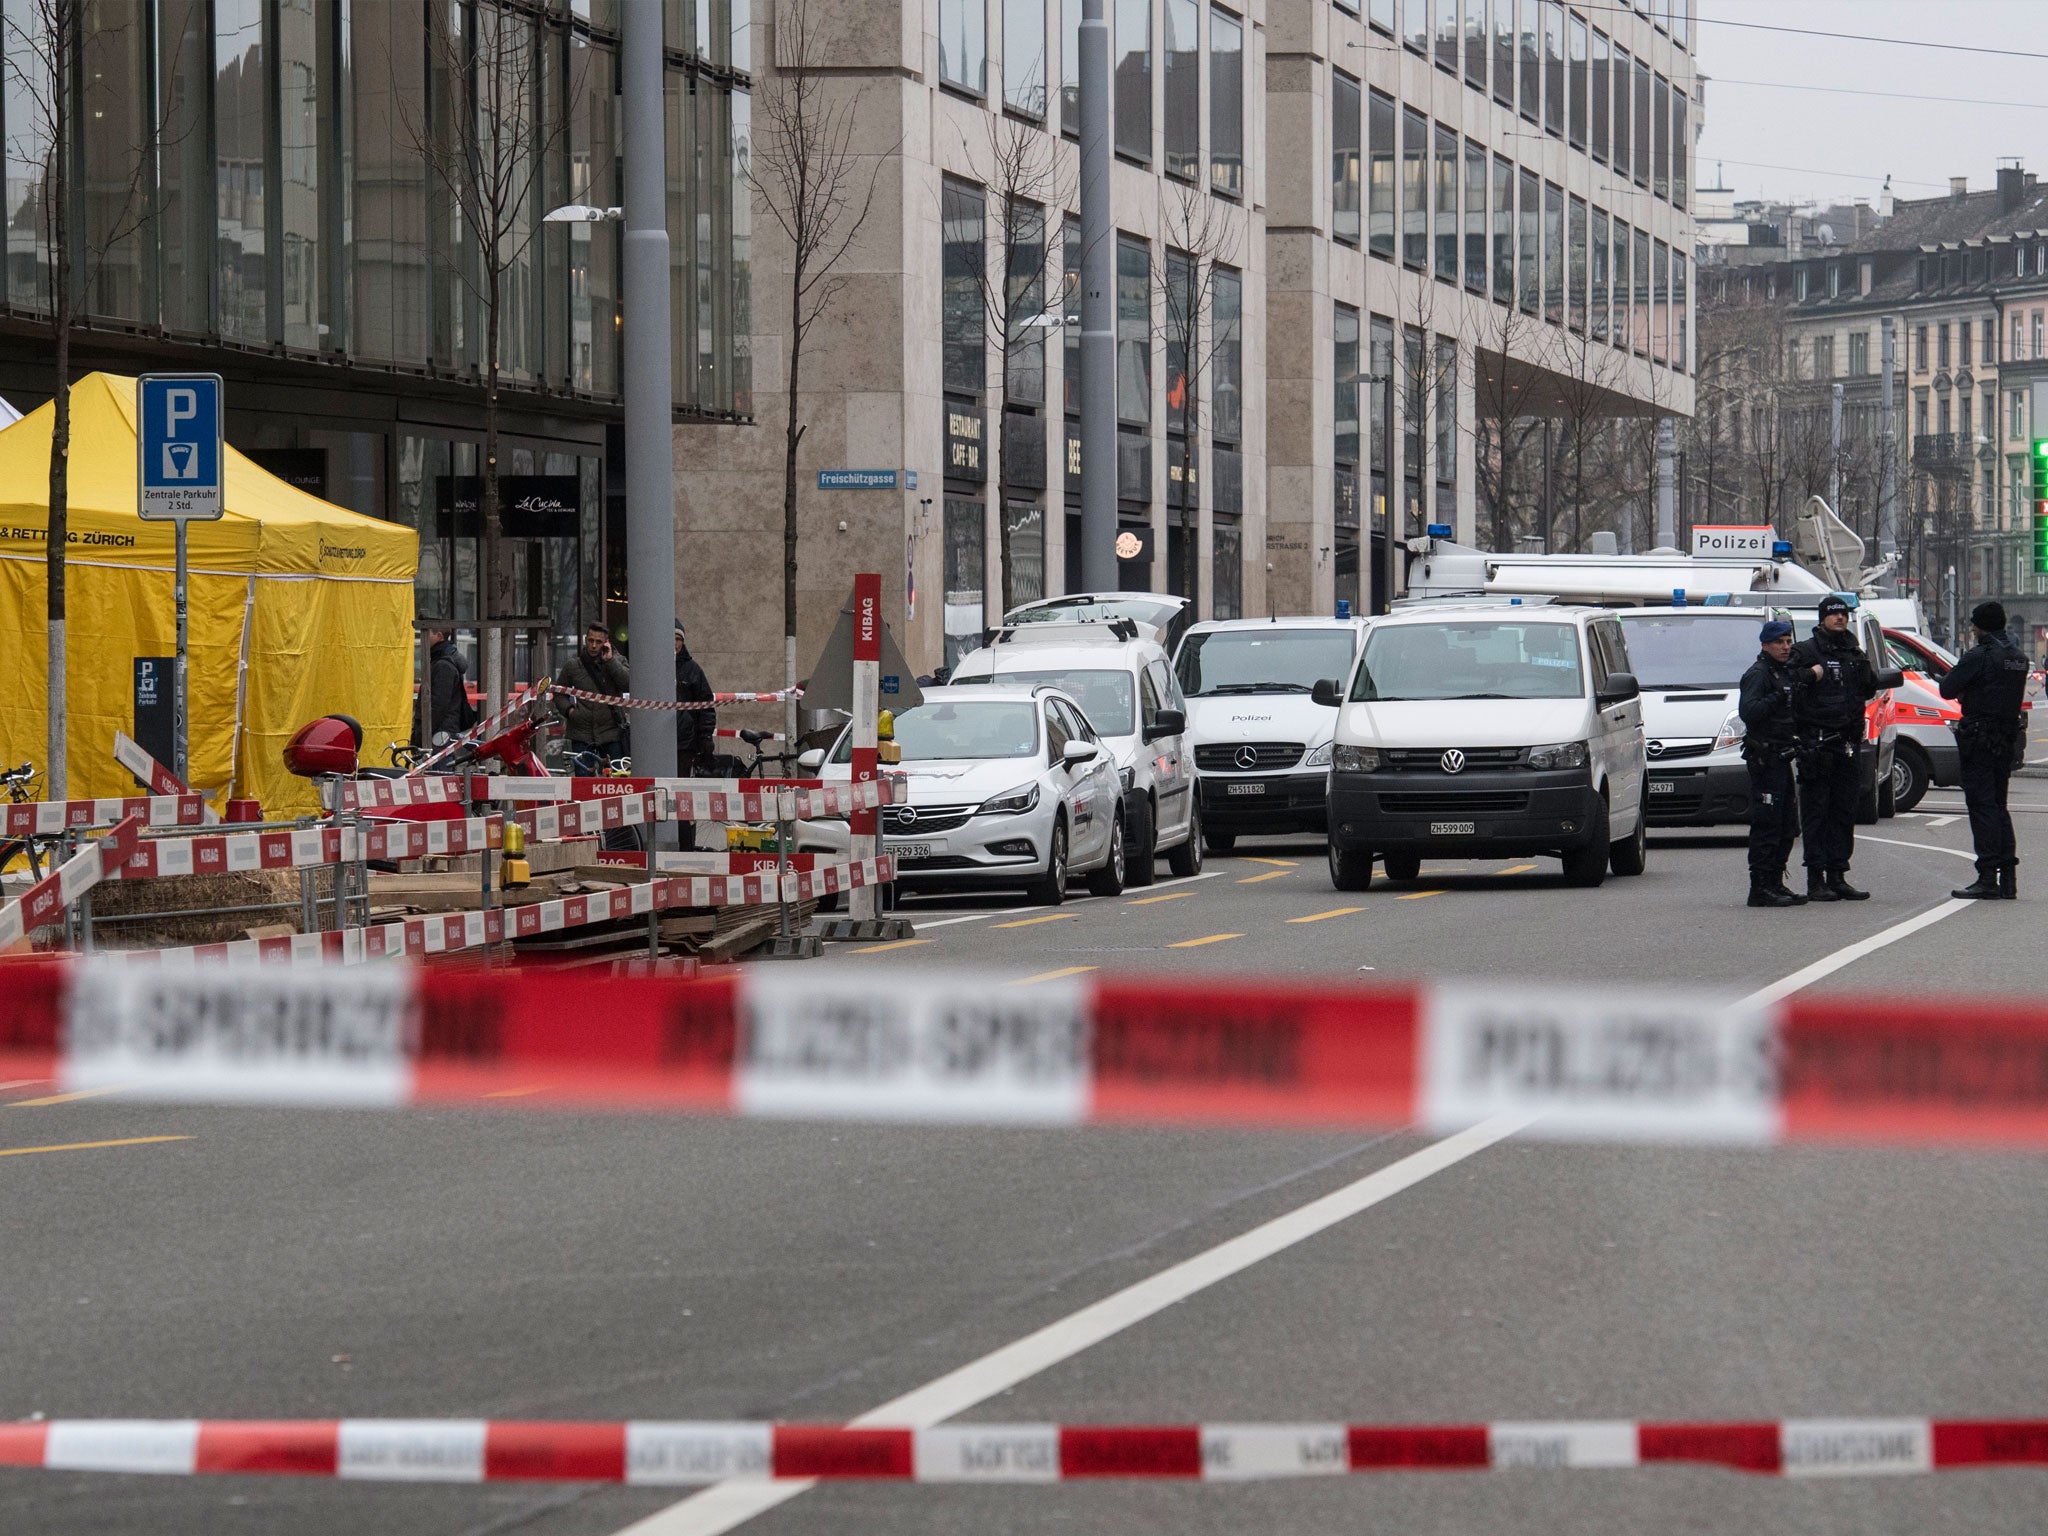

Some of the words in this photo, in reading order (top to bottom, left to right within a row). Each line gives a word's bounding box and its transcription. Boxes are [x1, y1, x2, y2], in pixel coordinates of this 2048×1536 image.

[166, 389, 197, 438] P
[821, 473, 894, 486] Freischützgasse
[144, 490, 181, 499] Zentrale
[183, 489, 217, 499] Parkuhr
[168, 501, 174, 510] 2
[176, 501, 193, 510] Std.
[12, 528, 78, 543] RETTG
[83, 531, 135, 547] ZÜRICH
[1699, 534, 1766, 549] Polizei
[861, 598, 873, 641] KIBAG
[142, 662, 153, 678] P
[1538, 658, 1570, 668] POLIZEI
[1231, 714, 1272, 722] Polizei
[592, 784, 634, 794] KIBAG
[32, 889, 53, 915] KIBAG
